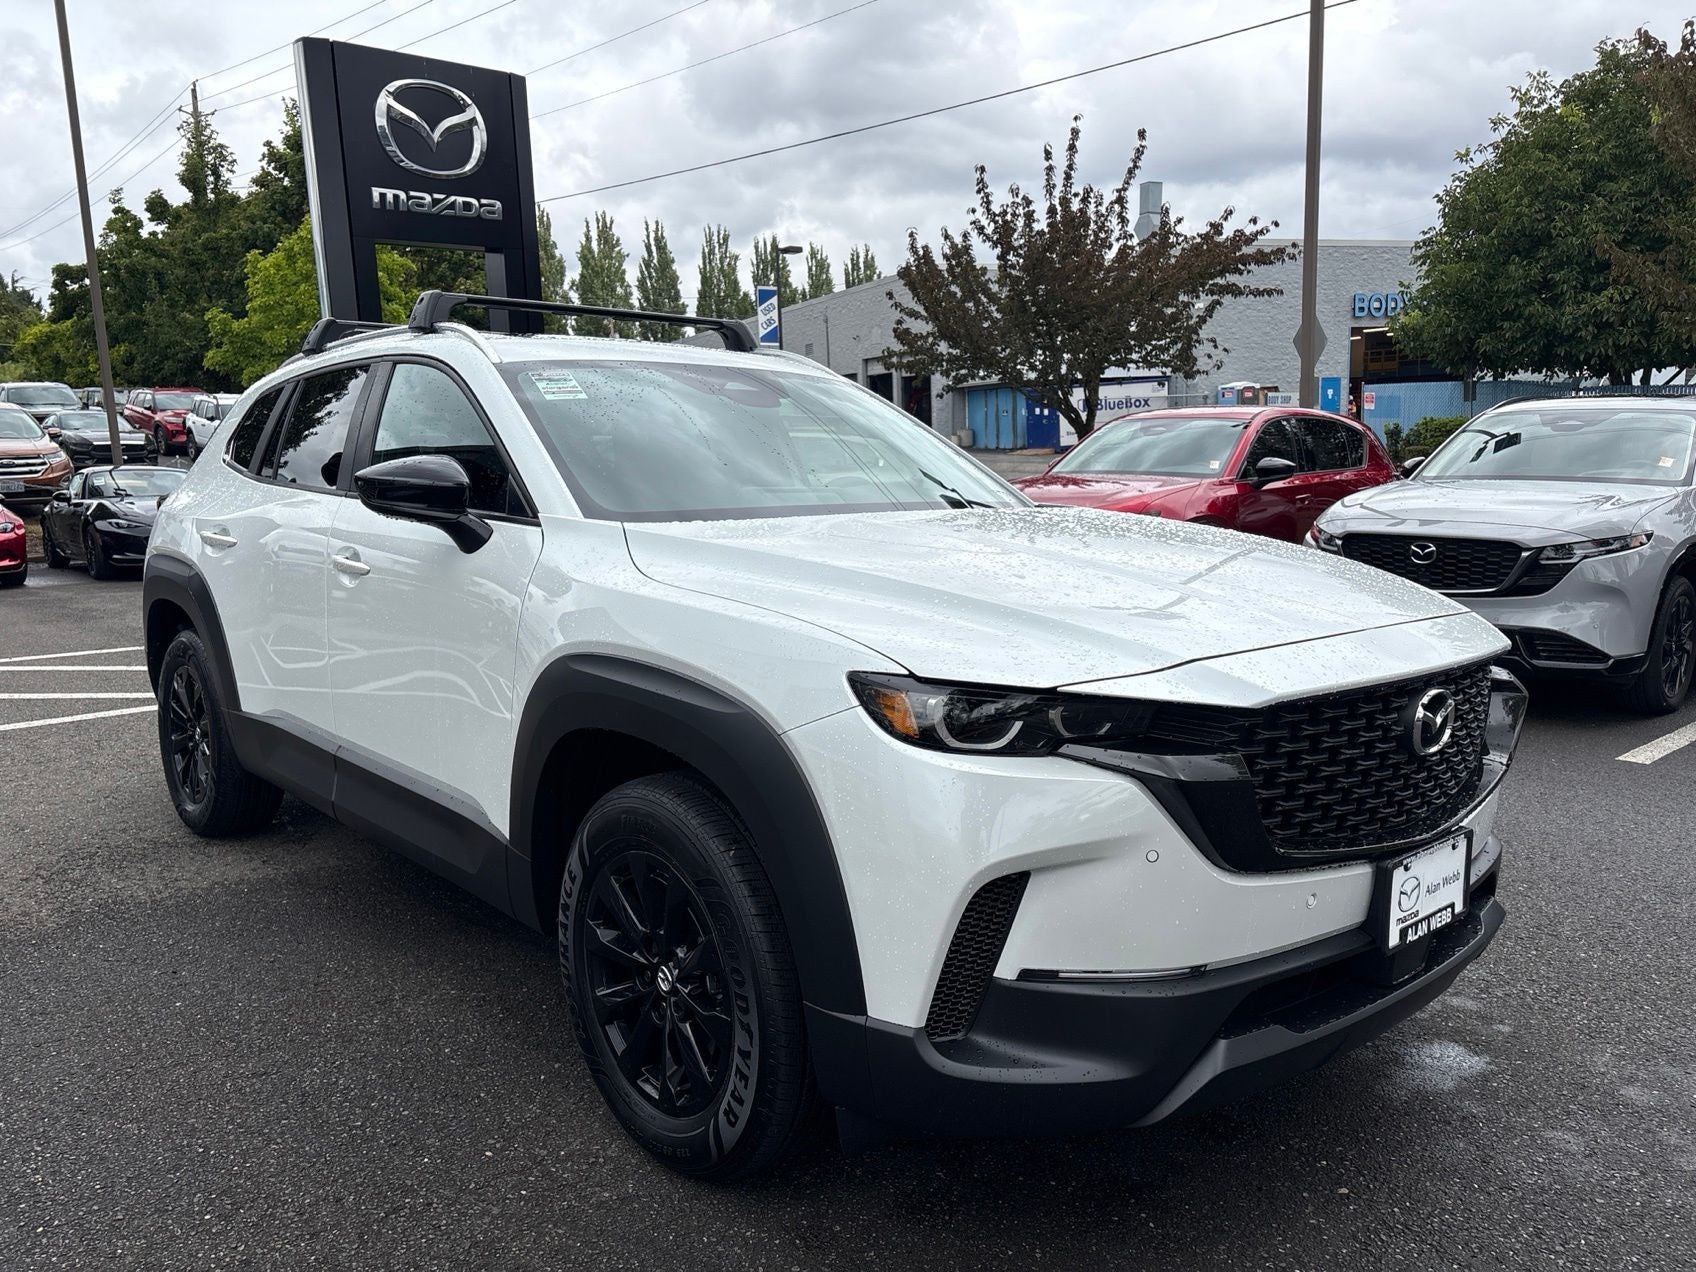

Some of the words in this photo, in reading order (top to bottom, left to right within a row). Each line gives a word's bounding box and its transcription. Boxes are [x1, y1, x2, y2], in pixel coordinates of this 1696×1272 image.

[371, 187, 503, 221] mazda
[1425, 882, 1441, 897] Alan
[1442, 869, 1460, 888] Webb
[1396, 910, 1419, 926] mazda
[1406, 918, 1428, 944] ALAN
[1429, 907, 1452, 931] WEBB
